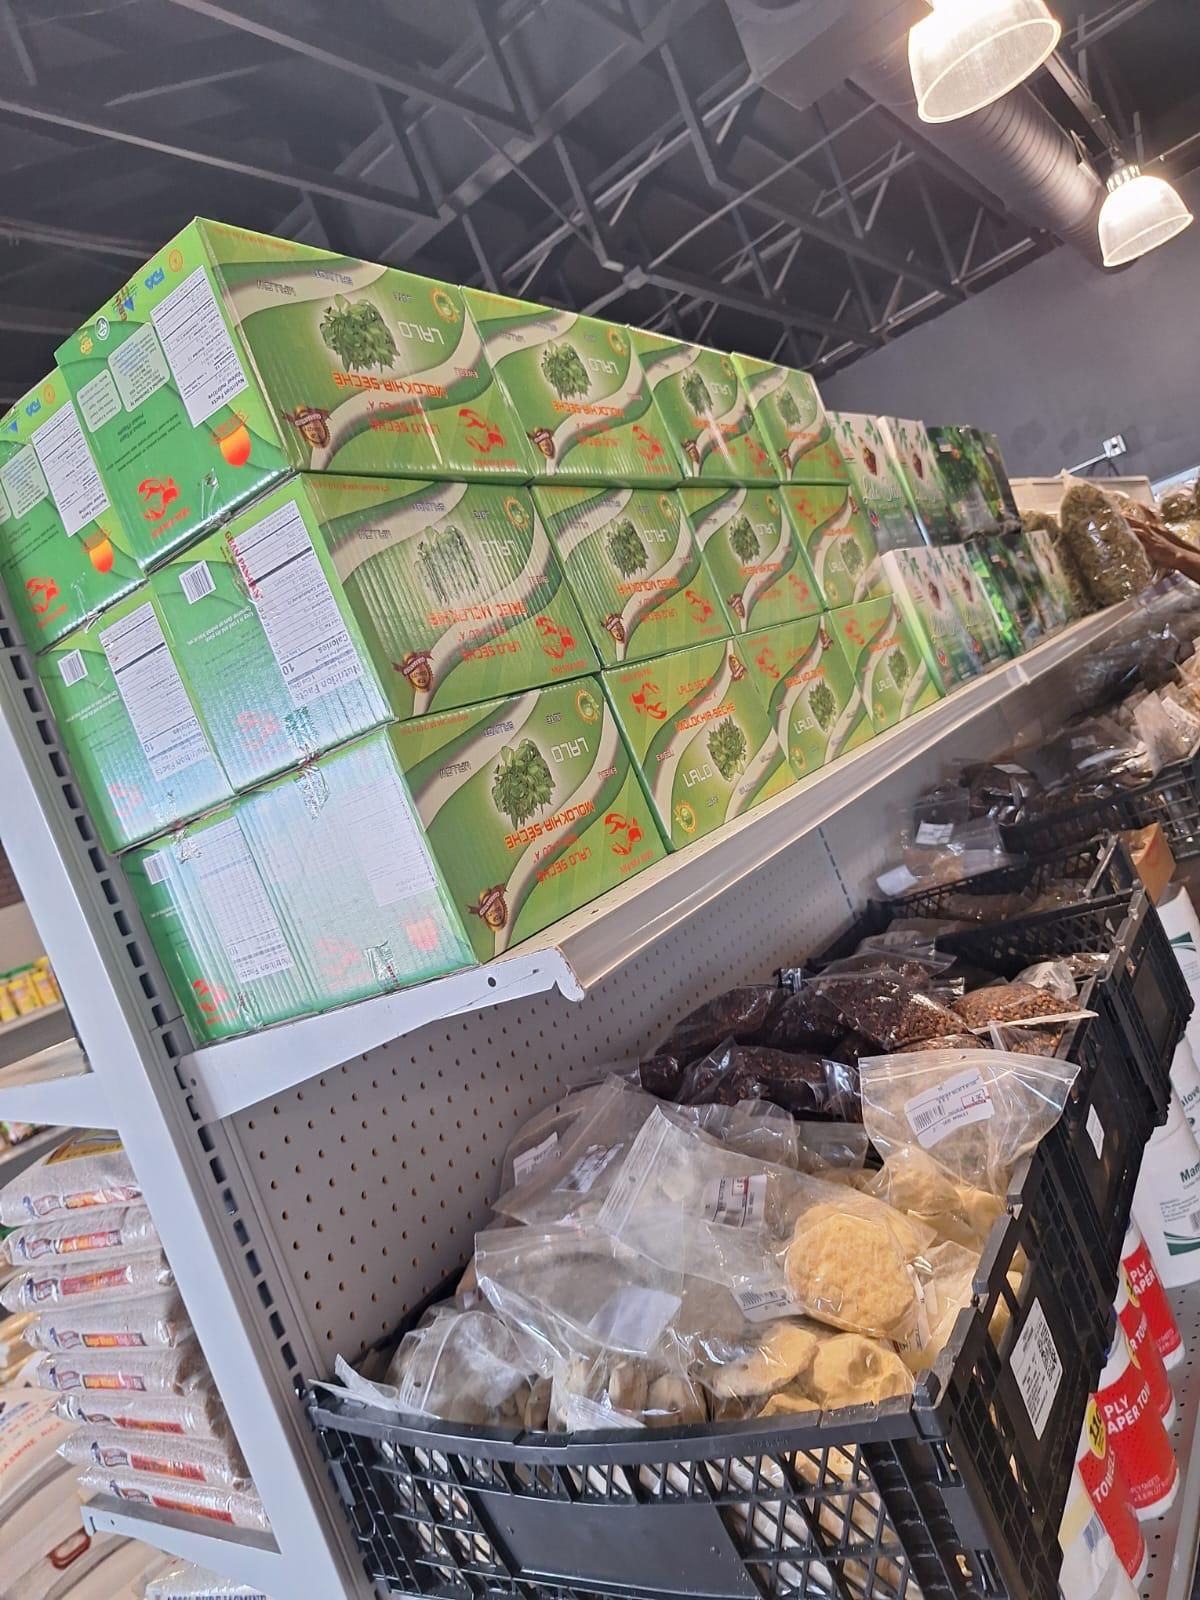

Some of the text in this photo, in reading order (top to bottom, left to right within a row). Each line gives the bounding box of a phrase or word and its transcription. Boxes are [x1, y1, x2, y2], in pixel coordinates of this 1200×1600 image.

[397, 320, 445, 345] LALO
[588, 358, 620, 375] LALO
[643, 529, 671, 542] LALO
[282, 634, 348, 676] Calories 10
[294, 663, 361, 702] Nutrition Facts
[154, 746, 209, 776] Nutrition Facts
[551, 737, 590, 763] LALO
[683, 765, 714, 788] LALO
[543, 800, 595, 832] MOLOKHIA
[568, 847, 592, 867] LALO
[1130, 1260, 1147, 1282] PLY
[1103, 1394, 1129, 1419] PLY
